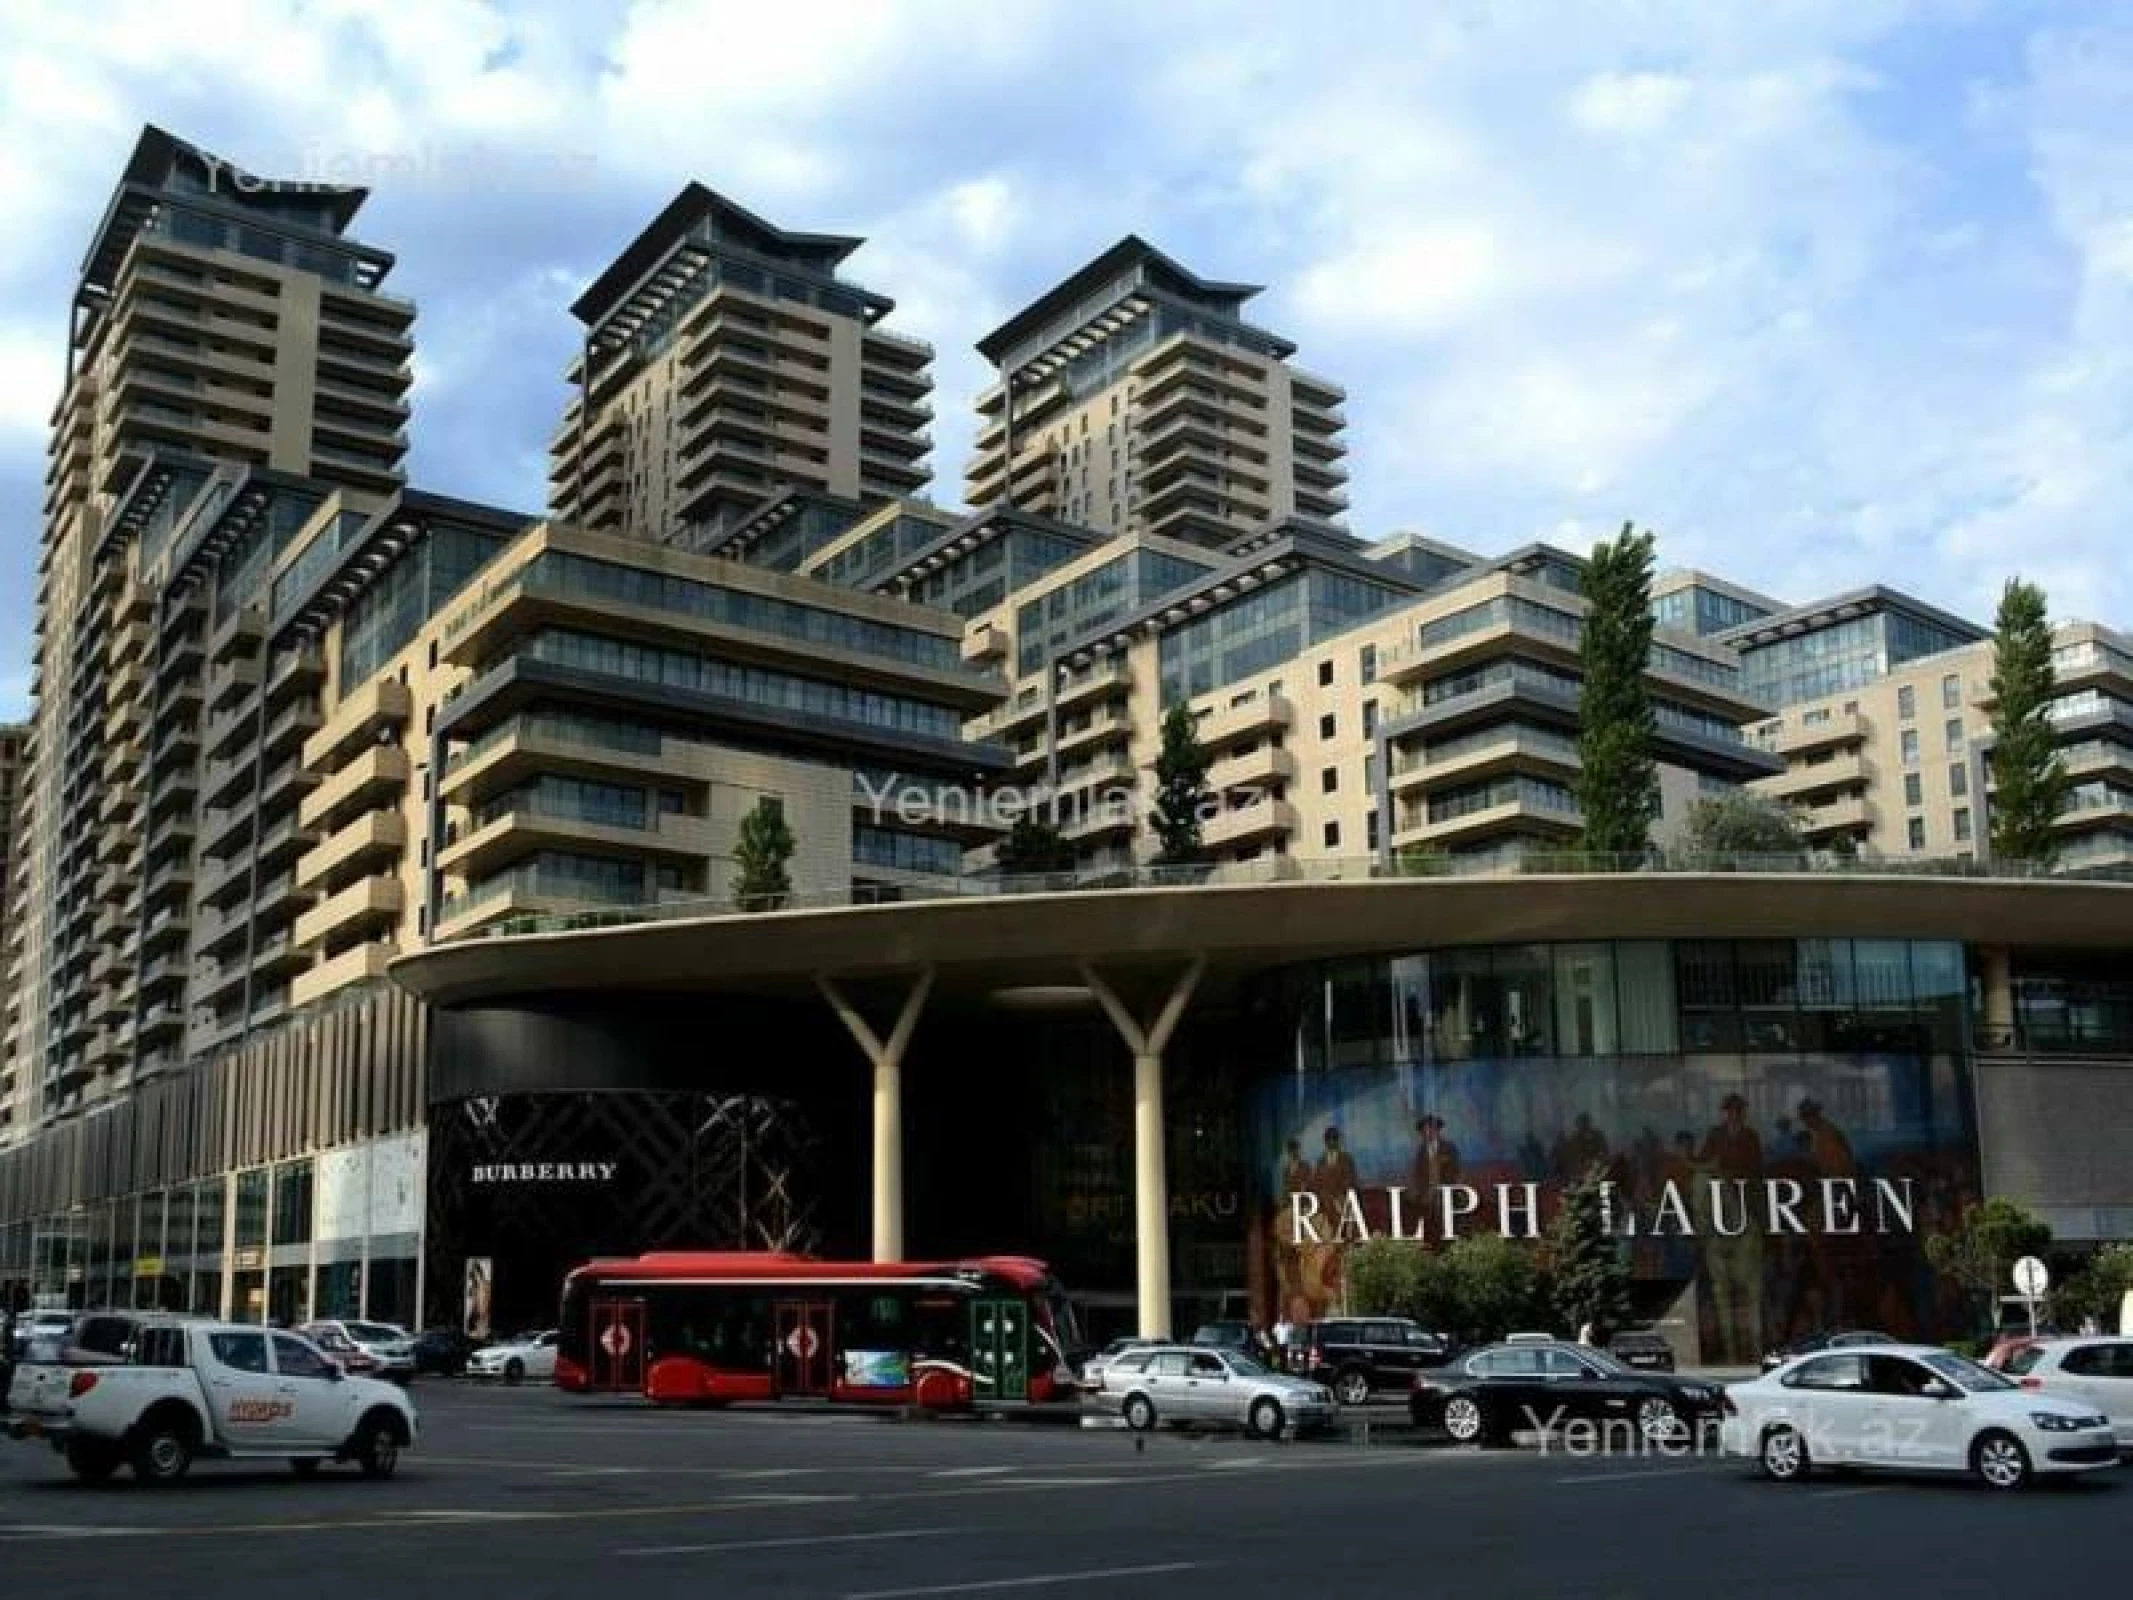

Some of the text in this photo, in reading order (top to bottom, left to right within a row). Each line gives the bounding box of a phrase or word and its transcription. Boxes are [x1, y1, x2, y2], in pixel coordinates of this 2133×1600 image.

[472, 1161, 617, 1183] BURBERRY
[1290, 1177, 1914, 1245] RALPH LAUREN
